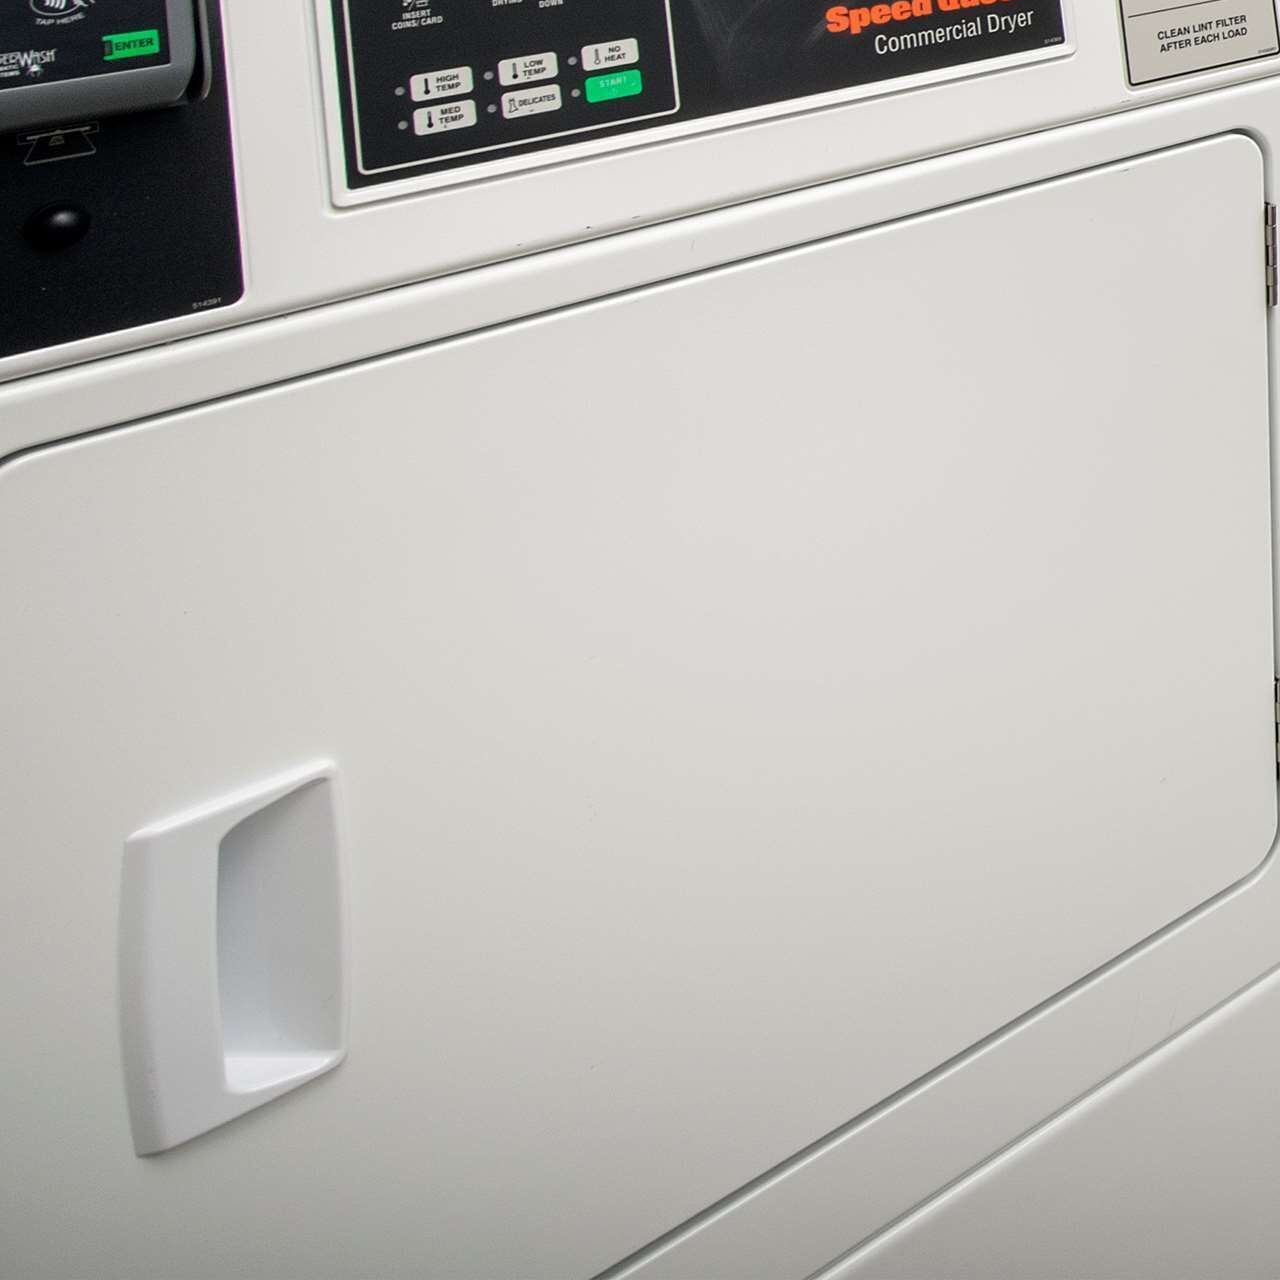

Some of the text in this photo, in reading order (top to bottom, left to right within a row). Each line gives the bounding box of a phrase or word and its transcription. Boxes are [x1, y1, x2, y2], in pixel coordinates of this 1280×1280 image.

[402, 9, 431, 20] INSERT
[420, 15, 443, 26] CARD
[875, 9, 1034, 55] Commercial Dryer
[1157, 14, 1247, 41] CLEAN LINT FILTER
[114, 36, 154, 51] ENTER
[1160, 27, 1248, 53] AFTER EACH LOAD
[607, 45, 622, 54] NO
[523, 58, 544, 69] LOW
[604, 53, 626, 63] HEAT
[523, 67, 547, 78] TEMP
[436, 73, 460, 84] HIGH
[436, 81, 461, 92] TEMP
[518, 93, 557, 107] DELICATES
[440, 105, 461, 116] MED
[438, 113, 464, 125] TEMP
